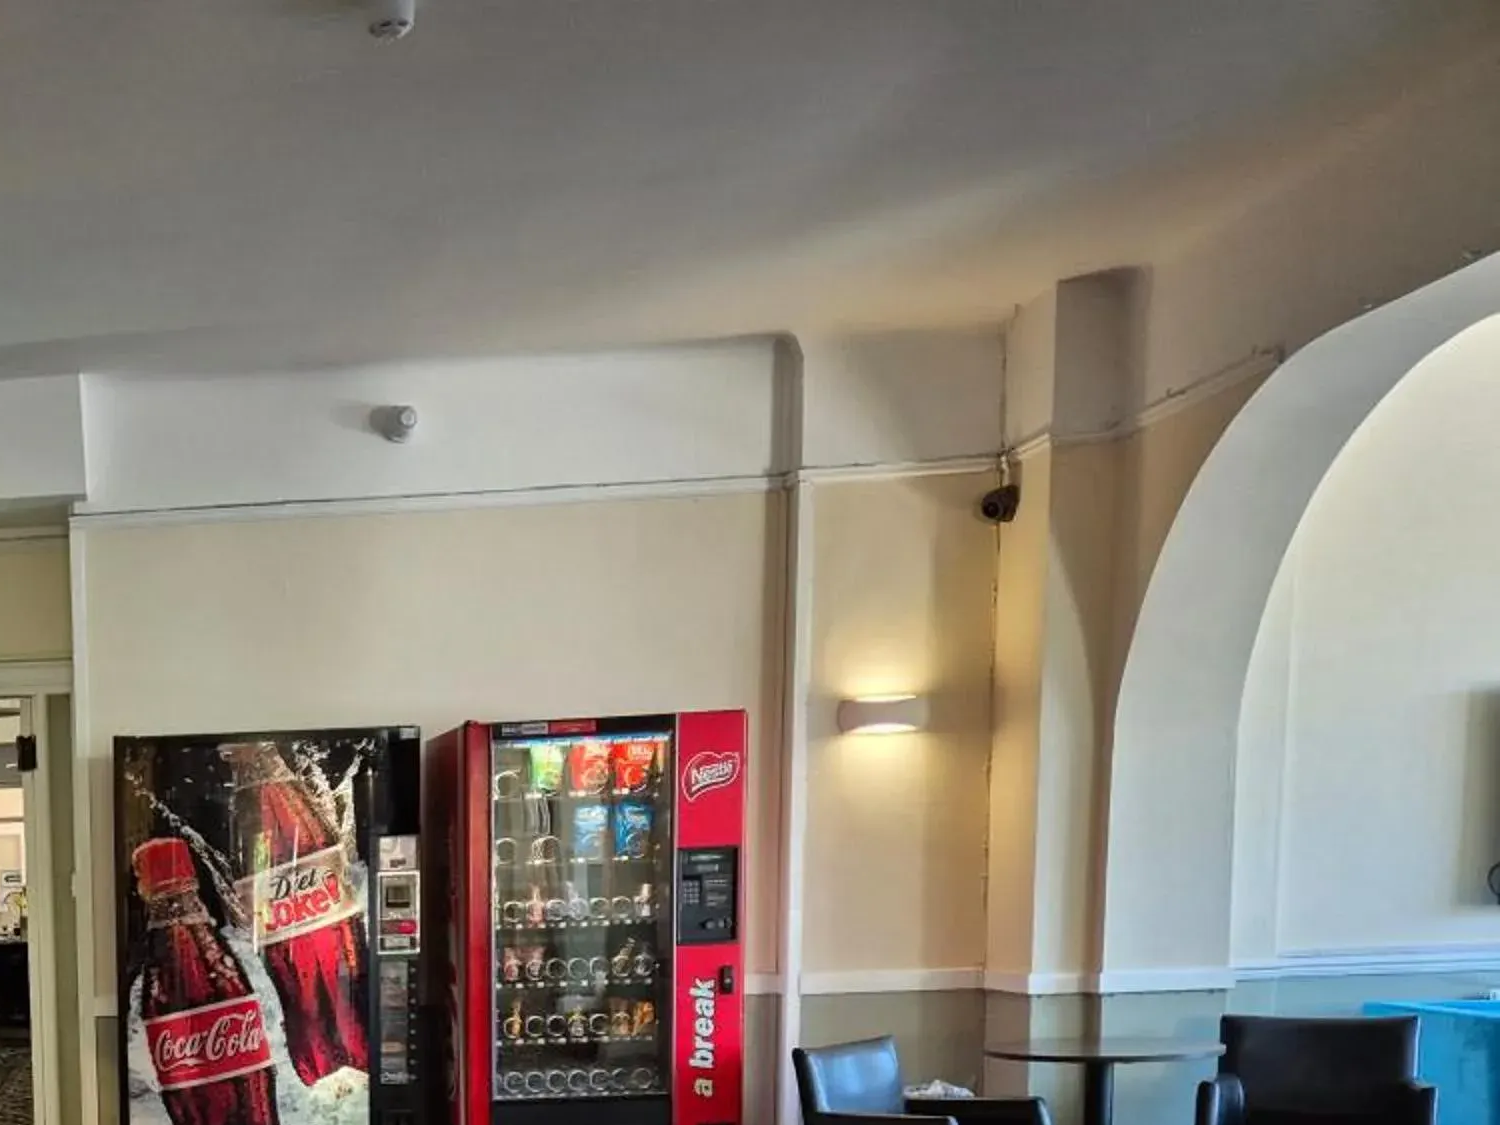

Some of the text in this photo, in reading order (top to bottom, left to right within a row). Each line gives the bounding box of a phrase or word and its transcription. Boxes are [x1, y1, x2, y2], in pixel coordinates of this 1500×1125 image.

[269, 867, 316, 901] Diet
[154, 1009, 260, 1072] Coca-Cola
[688, 978, 716, 1069] break
[694, 1079, 713, 1097] a
